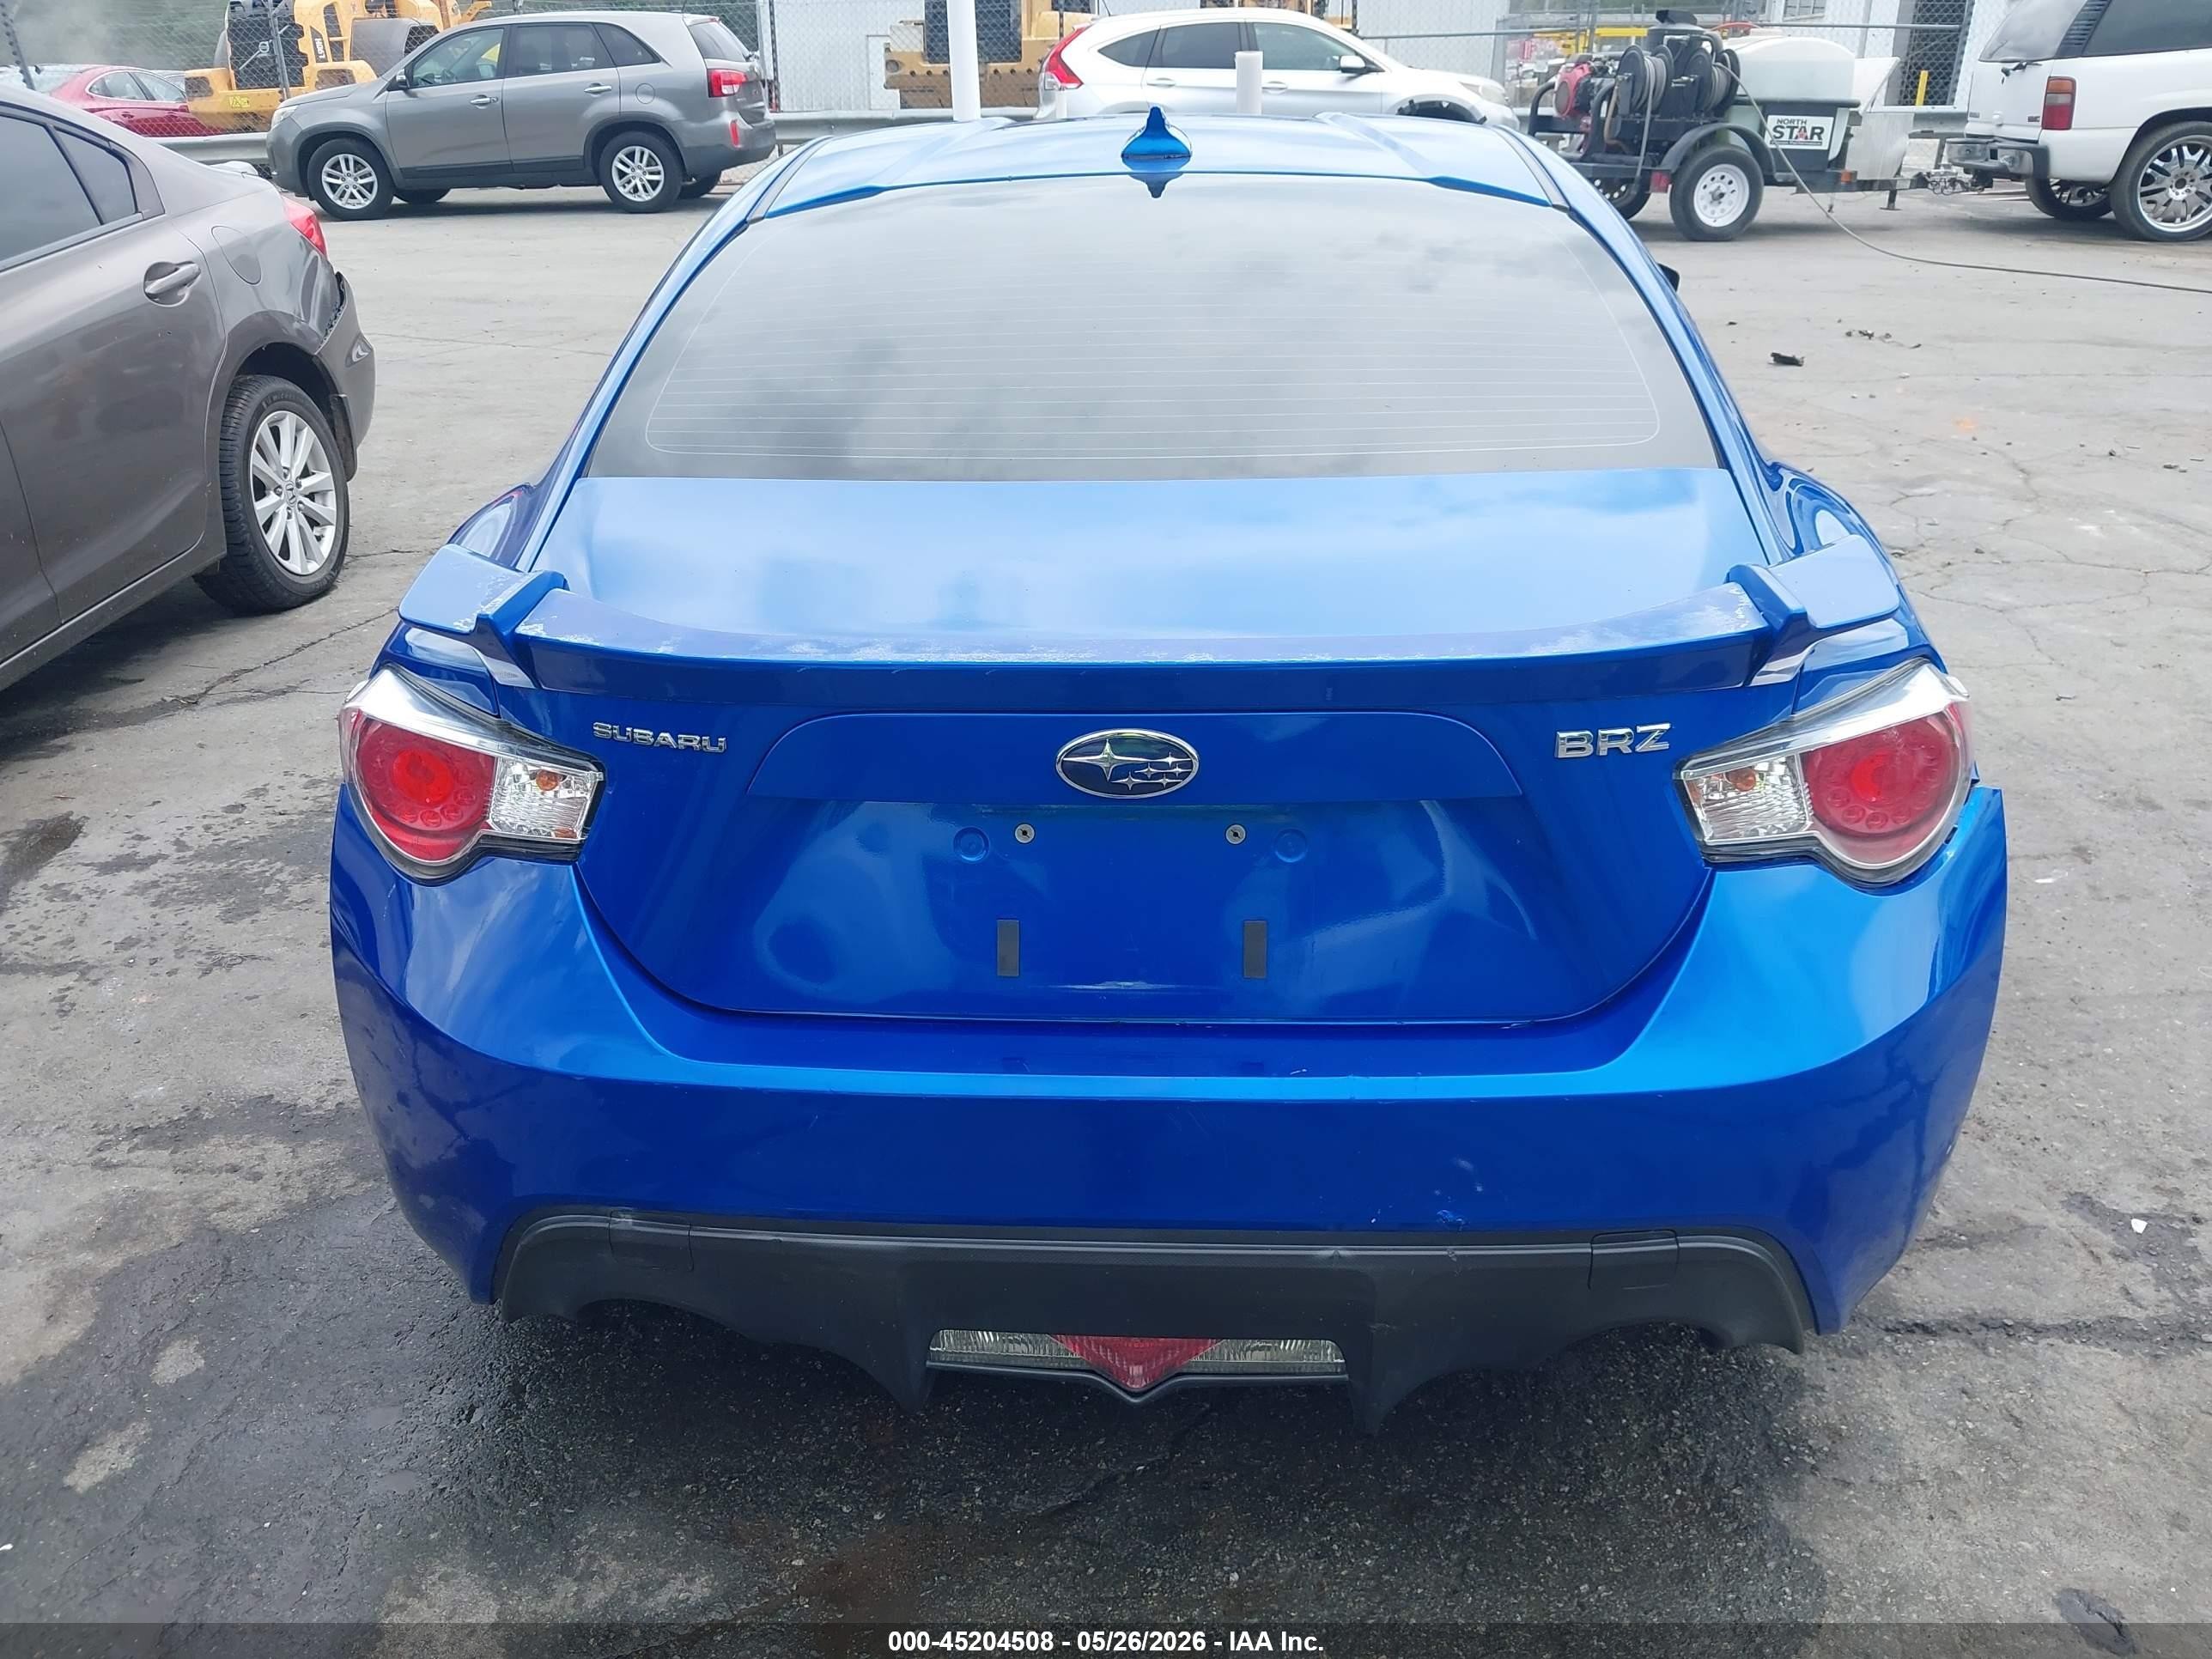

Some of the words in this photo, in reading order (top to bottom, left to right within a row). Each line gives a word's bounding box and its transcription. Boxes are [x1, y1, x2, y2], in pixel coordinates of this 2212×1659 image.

[1772, 125, 1825, 140] STAR
[592, 721, 727, 753] SUBARU
[1554, 722, 1671, 758] BRZ
